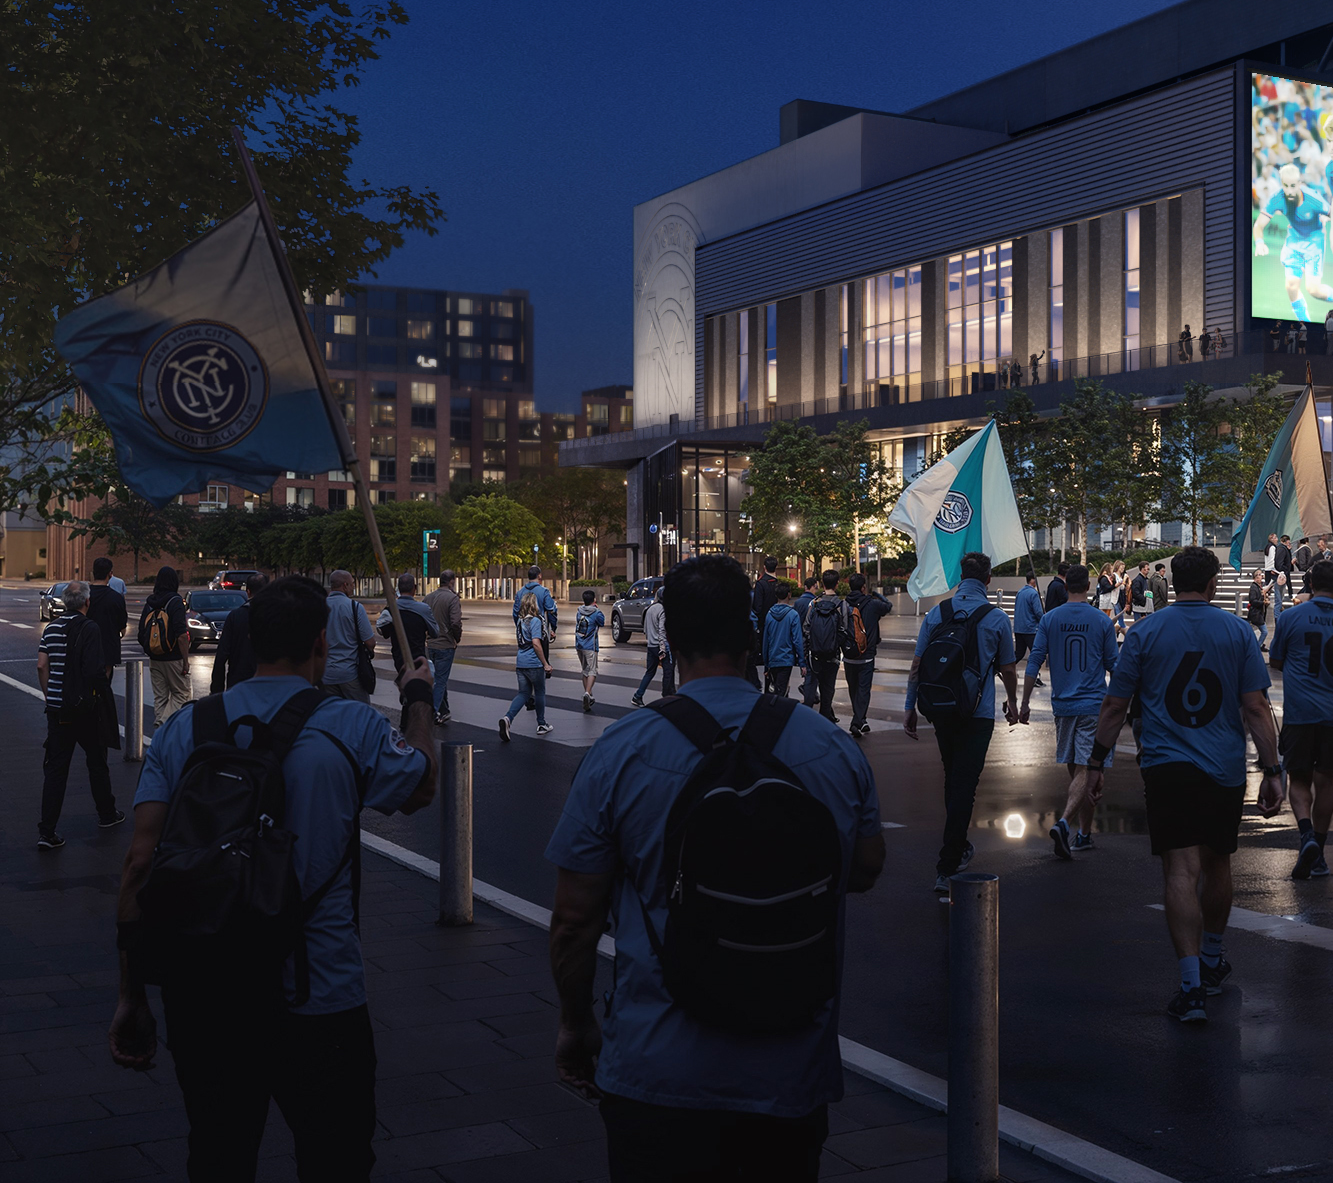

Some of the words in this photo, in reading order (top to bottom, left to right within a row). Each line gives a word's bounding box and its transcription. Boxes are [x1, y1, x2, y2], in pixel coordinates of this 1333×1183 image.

[150, 344, 170, 368] NEW
[171, 328, 202, 345] YORK
[205, 328, 231, 342] CITY
[1164, 651, 1223, 729] 6
